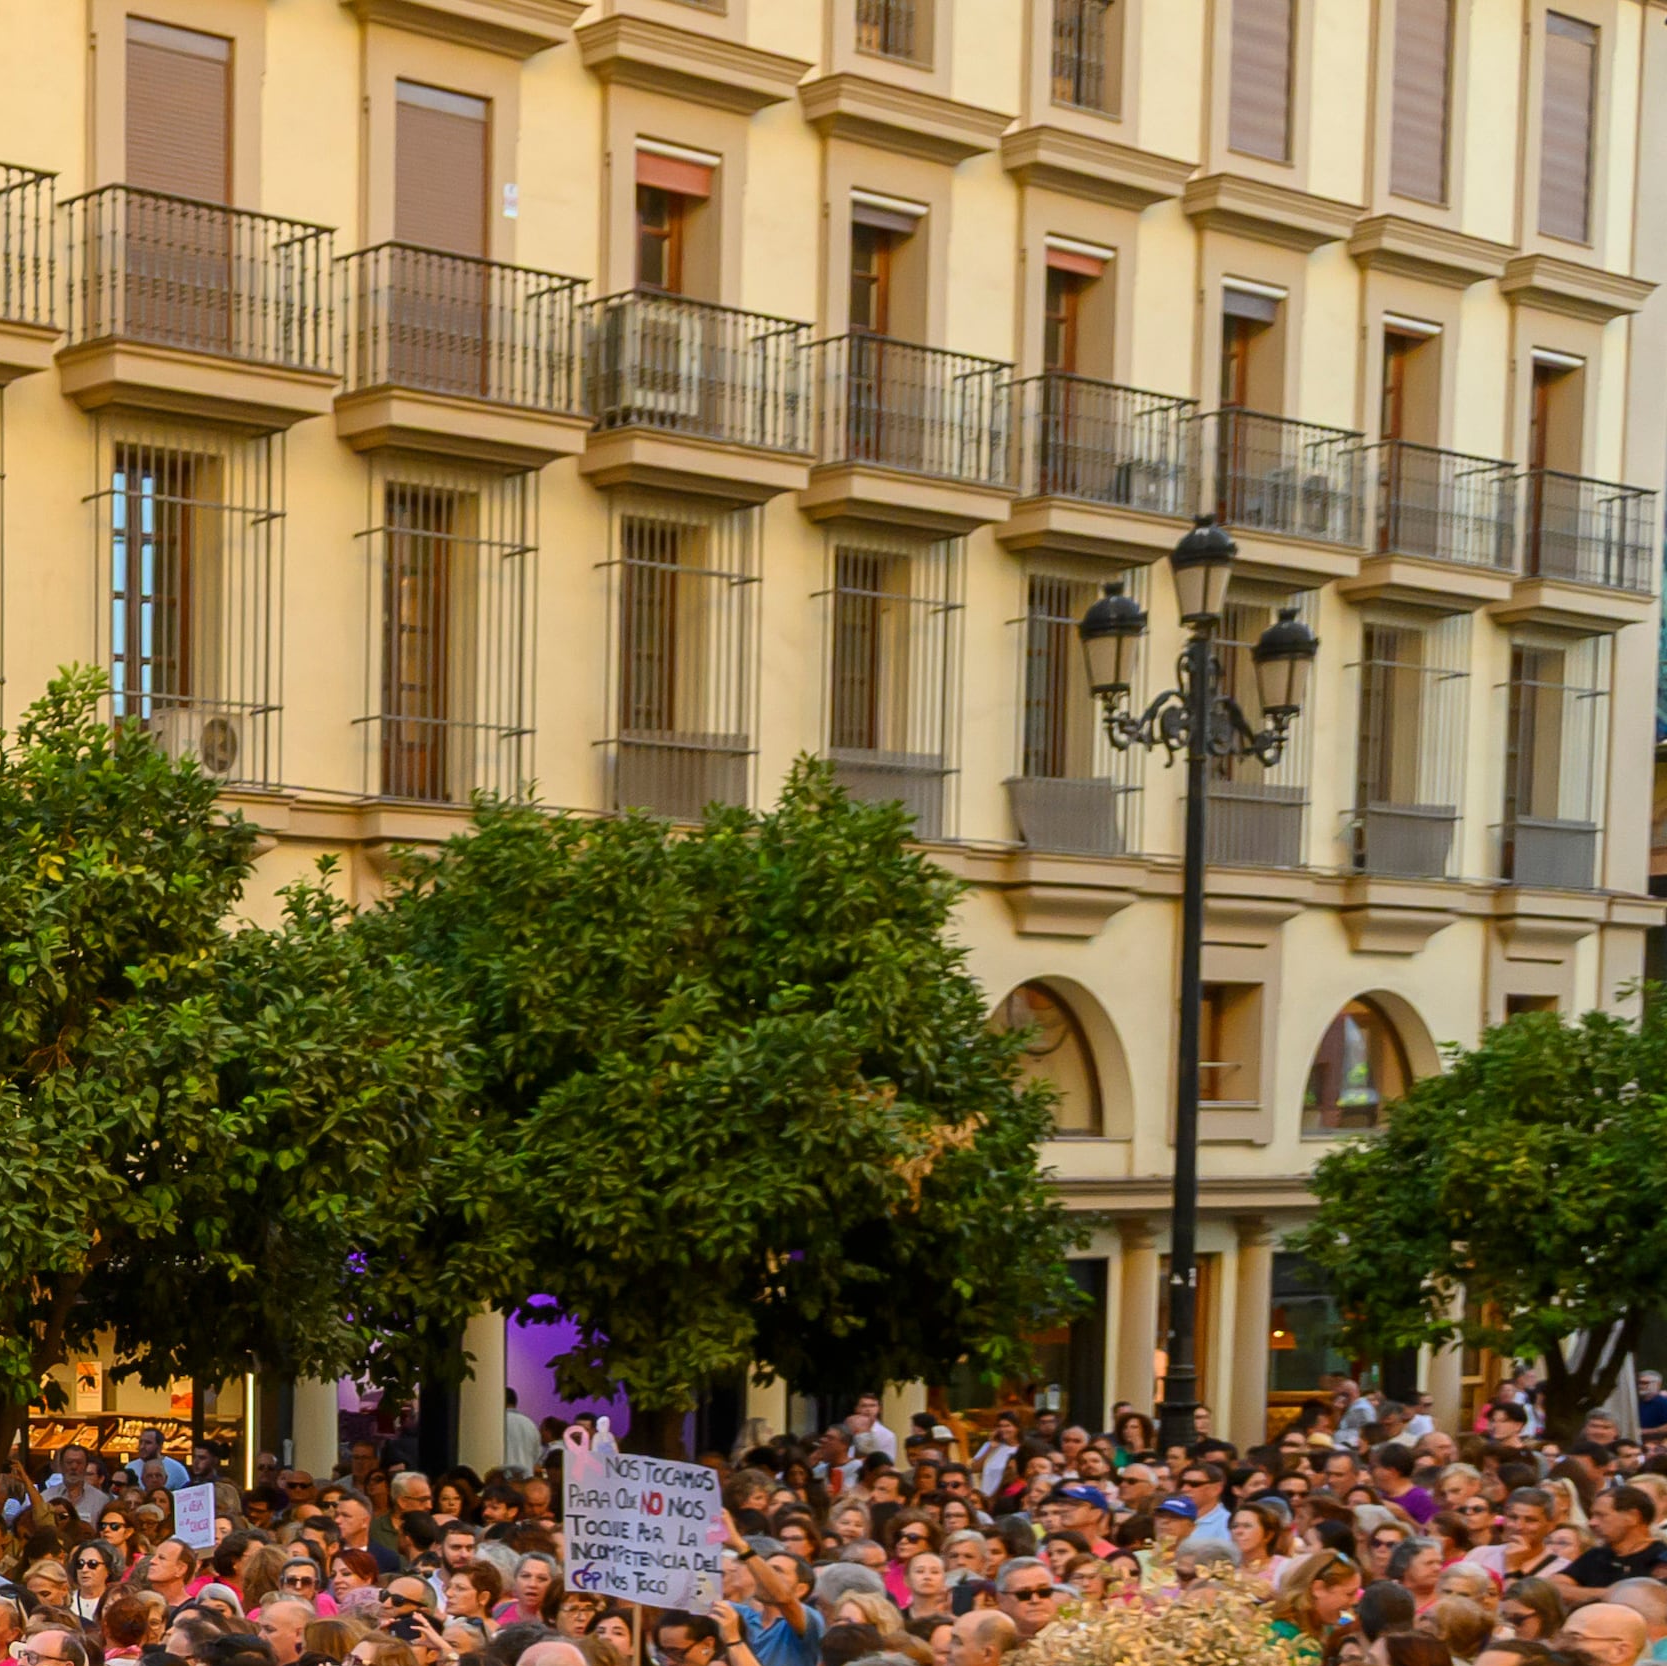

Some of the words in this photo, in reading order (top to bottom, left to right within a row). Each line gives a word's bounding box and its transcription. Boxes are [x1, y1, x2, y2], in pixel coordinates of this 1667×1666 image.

[605, 1457, 640, 1481] NOS
[643, 1461, 715, 1491] TOCAMOS
[568, 1483, 611, 1508] PARA
[640, 1489, 664, 1516] NO
[667, 1496, 706, 1520] NOS
[637, 1522, 665, 1543] POR
[678, 1524, 698, 1546] LA
[570, 1542, 690, 1569] INCOMPETENCIA
[693, 1552, 724, 1573] DEL
